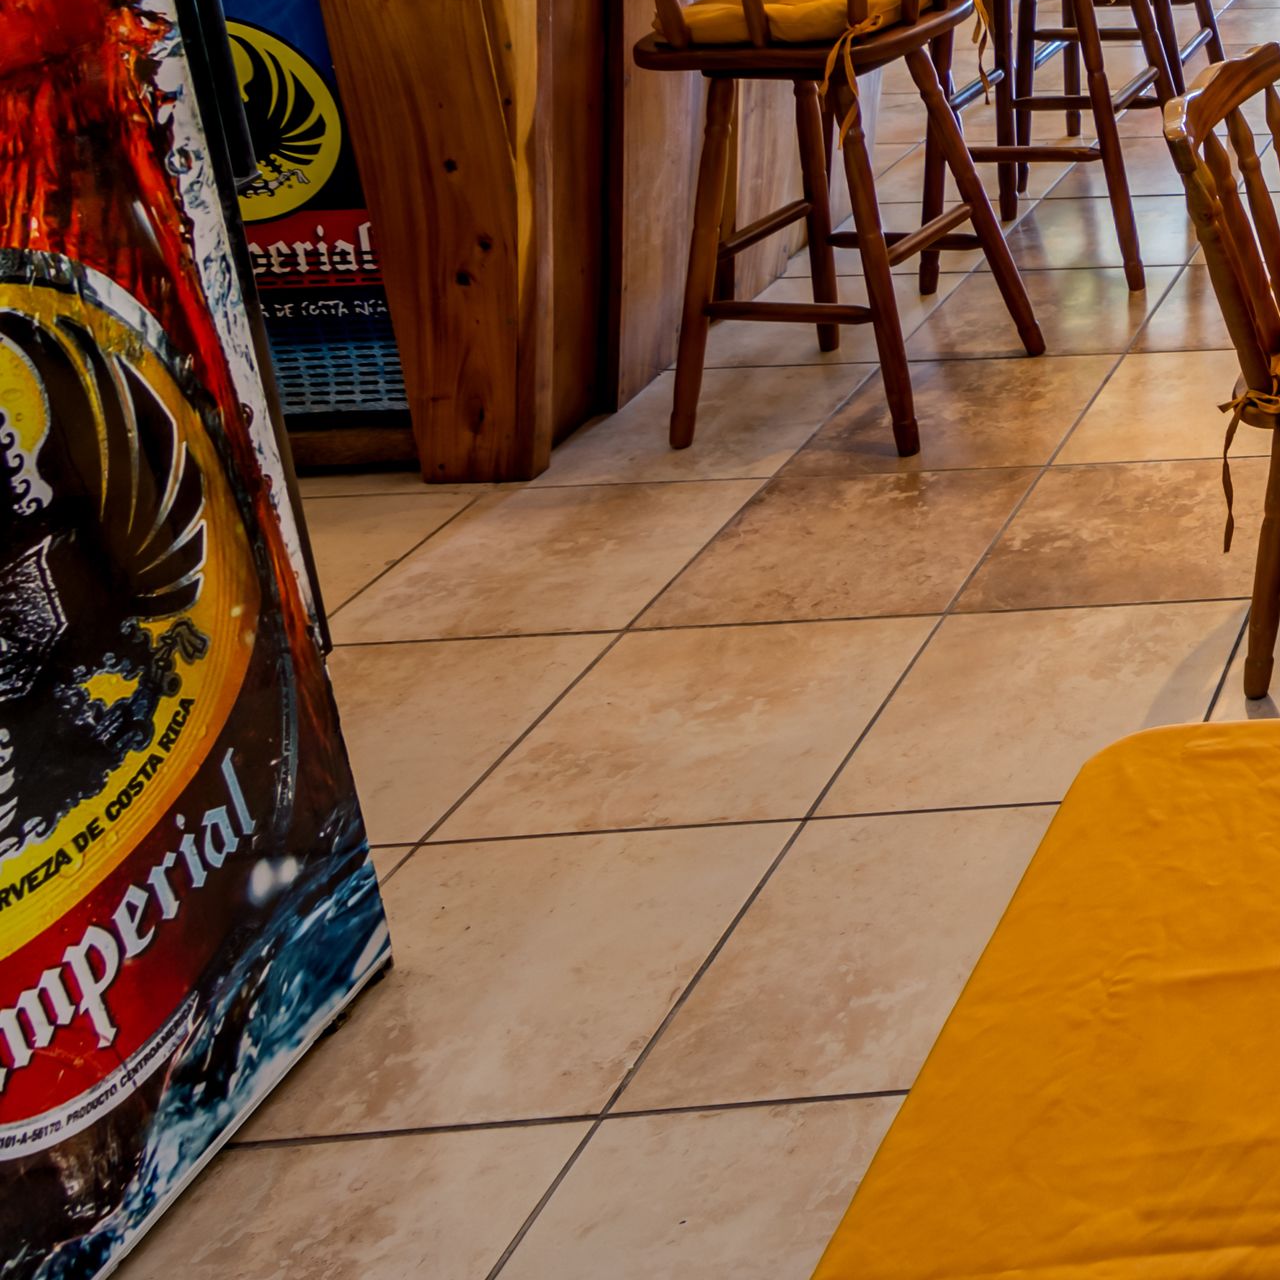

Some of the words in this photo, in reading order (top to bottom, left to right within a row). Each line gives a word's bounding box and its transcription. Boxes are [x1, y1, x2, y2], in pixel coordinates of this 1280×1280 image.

[71, 817, 105, 854] DE
[105, 753, 165, 822] COSTA
[157, 698, 195, 753] RICA
[0, 747, 256, 1092] mperial
